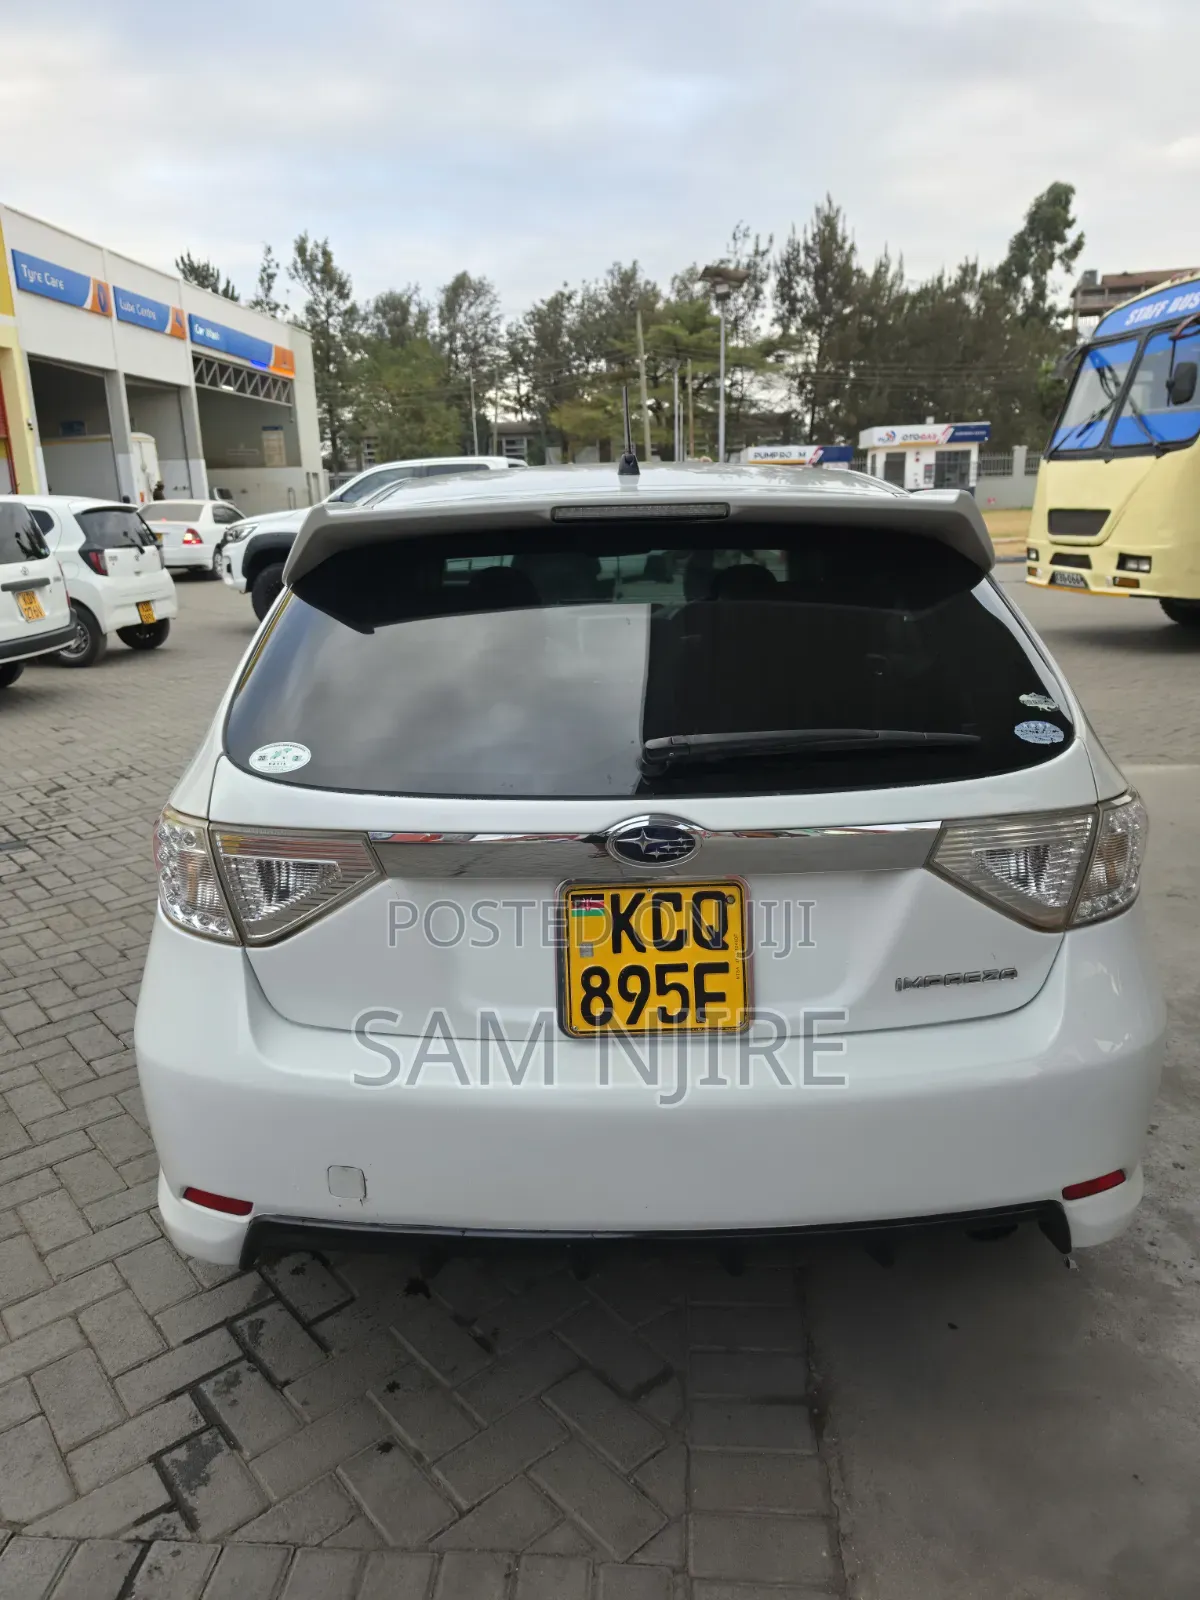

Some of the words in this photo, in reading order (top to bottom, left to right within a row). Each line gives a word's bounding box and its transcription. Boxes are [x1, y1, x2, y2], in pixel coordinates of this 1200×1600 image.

[21, 264, 42, 282] Tyre
[44, 273, 64, 290] Care
[1124, 300, 1169, 326] STAFF
[610, 891, 729, 954] KCQ
[895, 968, 1018, 992] IMPREZA
[581, 962, 730, 1027] 895F
